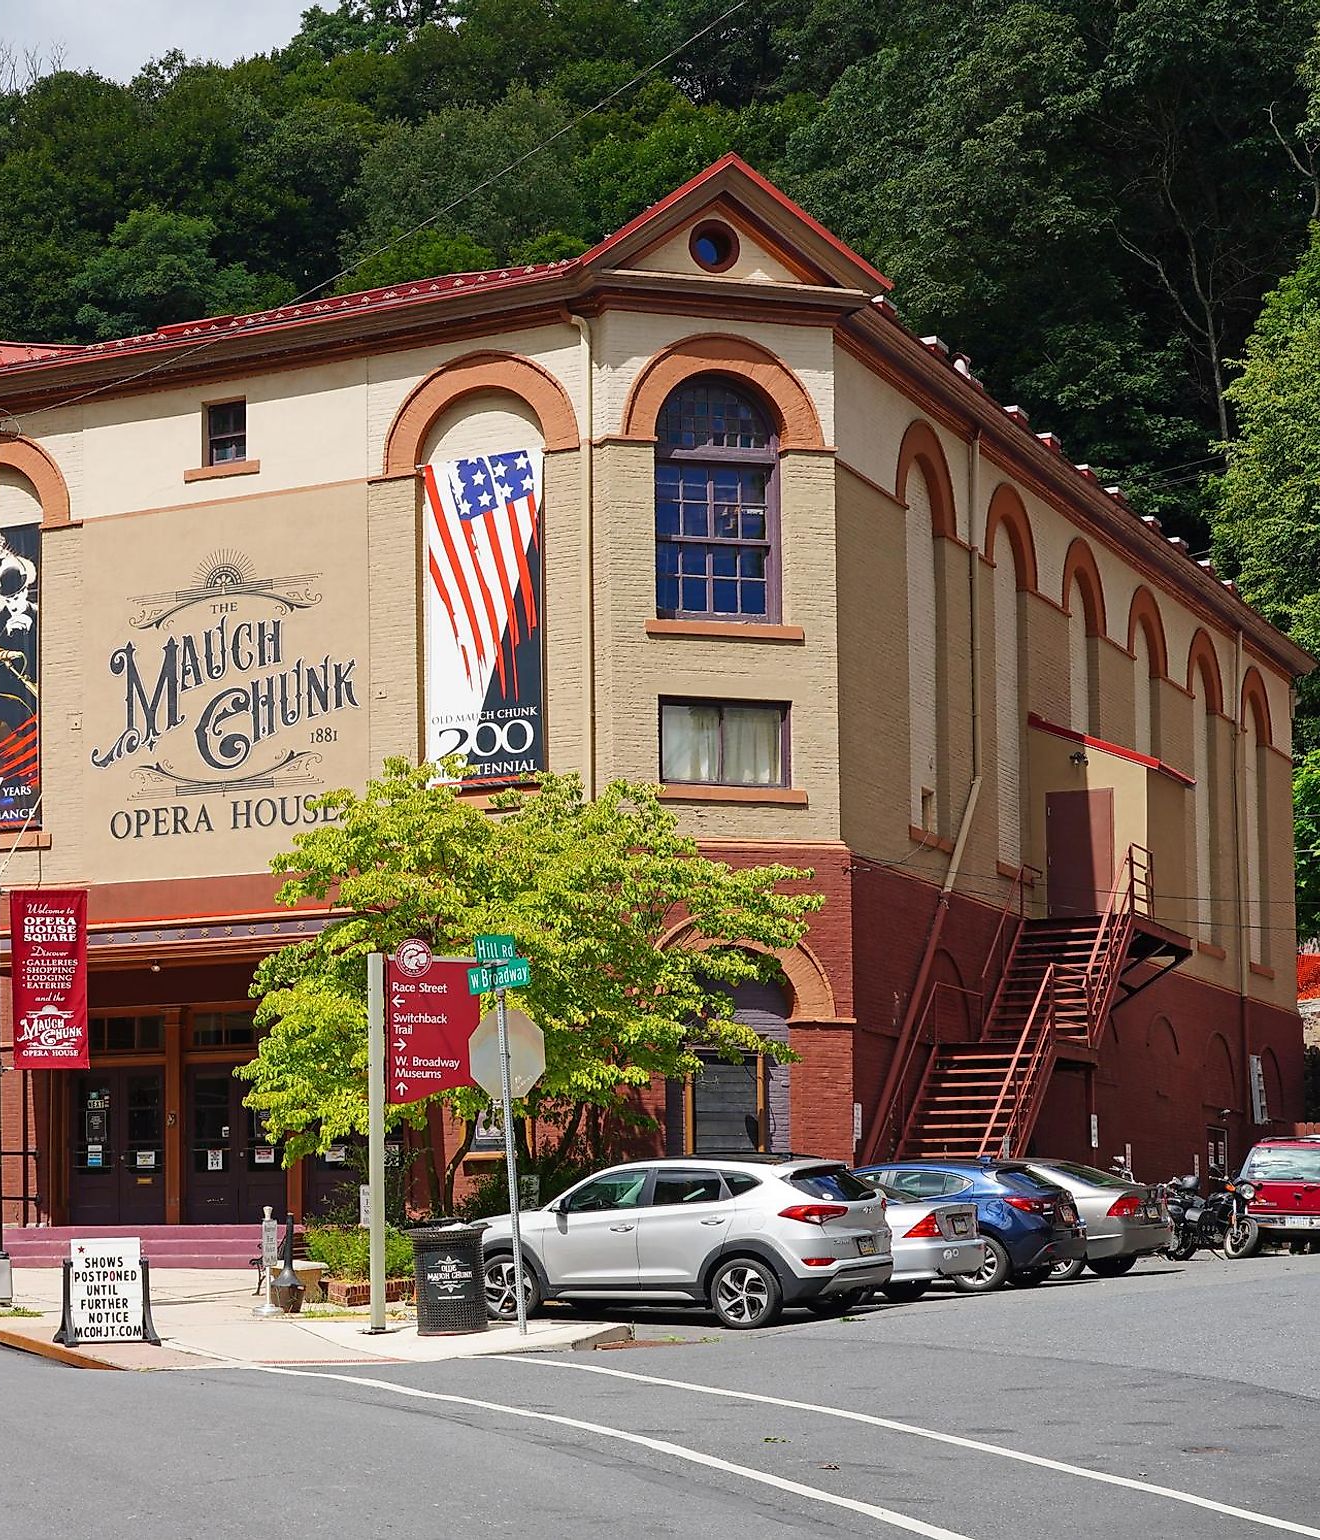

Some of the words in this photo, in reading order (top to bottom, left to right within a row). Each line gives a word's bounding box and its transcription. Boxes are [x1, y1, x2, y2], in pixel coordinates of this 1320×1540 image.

[210, 602, 238, 614] THE
[432, 715, 453, 725] OLD
[456, 710, 496, 722] MAUCH
[497, 706, 538, 719] CHUNK
[311, 730, 338, 743] 1881
[436, 719, 534, 762] 200
[2, 785, 32, 797] YEARS
[110, 804, 214, 839] OPERA
[231, 794, 339, 830] HOUSE
[27, 903, 65, 914] Welcome
[23, 916, 77, 925] OPERA
[24, 925, 77, 934] HOUSE
[23, 934, 77, 943] SQUARE
[30, 945, 69, 957] Discover
[477, 940, 499, 958] Hill
[502, 944, 514, 957] Rd
[26, 966, 76, 974] SHOPPING
[470, 974, 479, 989] W
[481, 965, 528, 988] Broadway
[392, 982, 416, 993] Race
[419, 982, 448, 994] Street
[35, 992, 52, 1002] and
[53, 992, 65, 1002] the
[393, 1012, 448, 1024] Switchback
[393, 1024, 413, 1035] Trail
[22, 1049, 49, 1057] OPERA
[52, 1049, 79, 1057] HOUSE
[394, 1056, 408, 1067] W.
[412, 1056, 460, 1070] Broadway
[394, 1068, 442, 1079] Museums
[85, 1256, 123, 1268] SHOWS
[74, 1270, 137, 1283] POSTPONED
[86, 1285, 118, 1296] UNTIL
[80, 1298, 128, 1310] FURTHER
[88, 1312, 129, 1324] NOTICE
[74, 1325, 142, 1338] MCOHJT.COM
